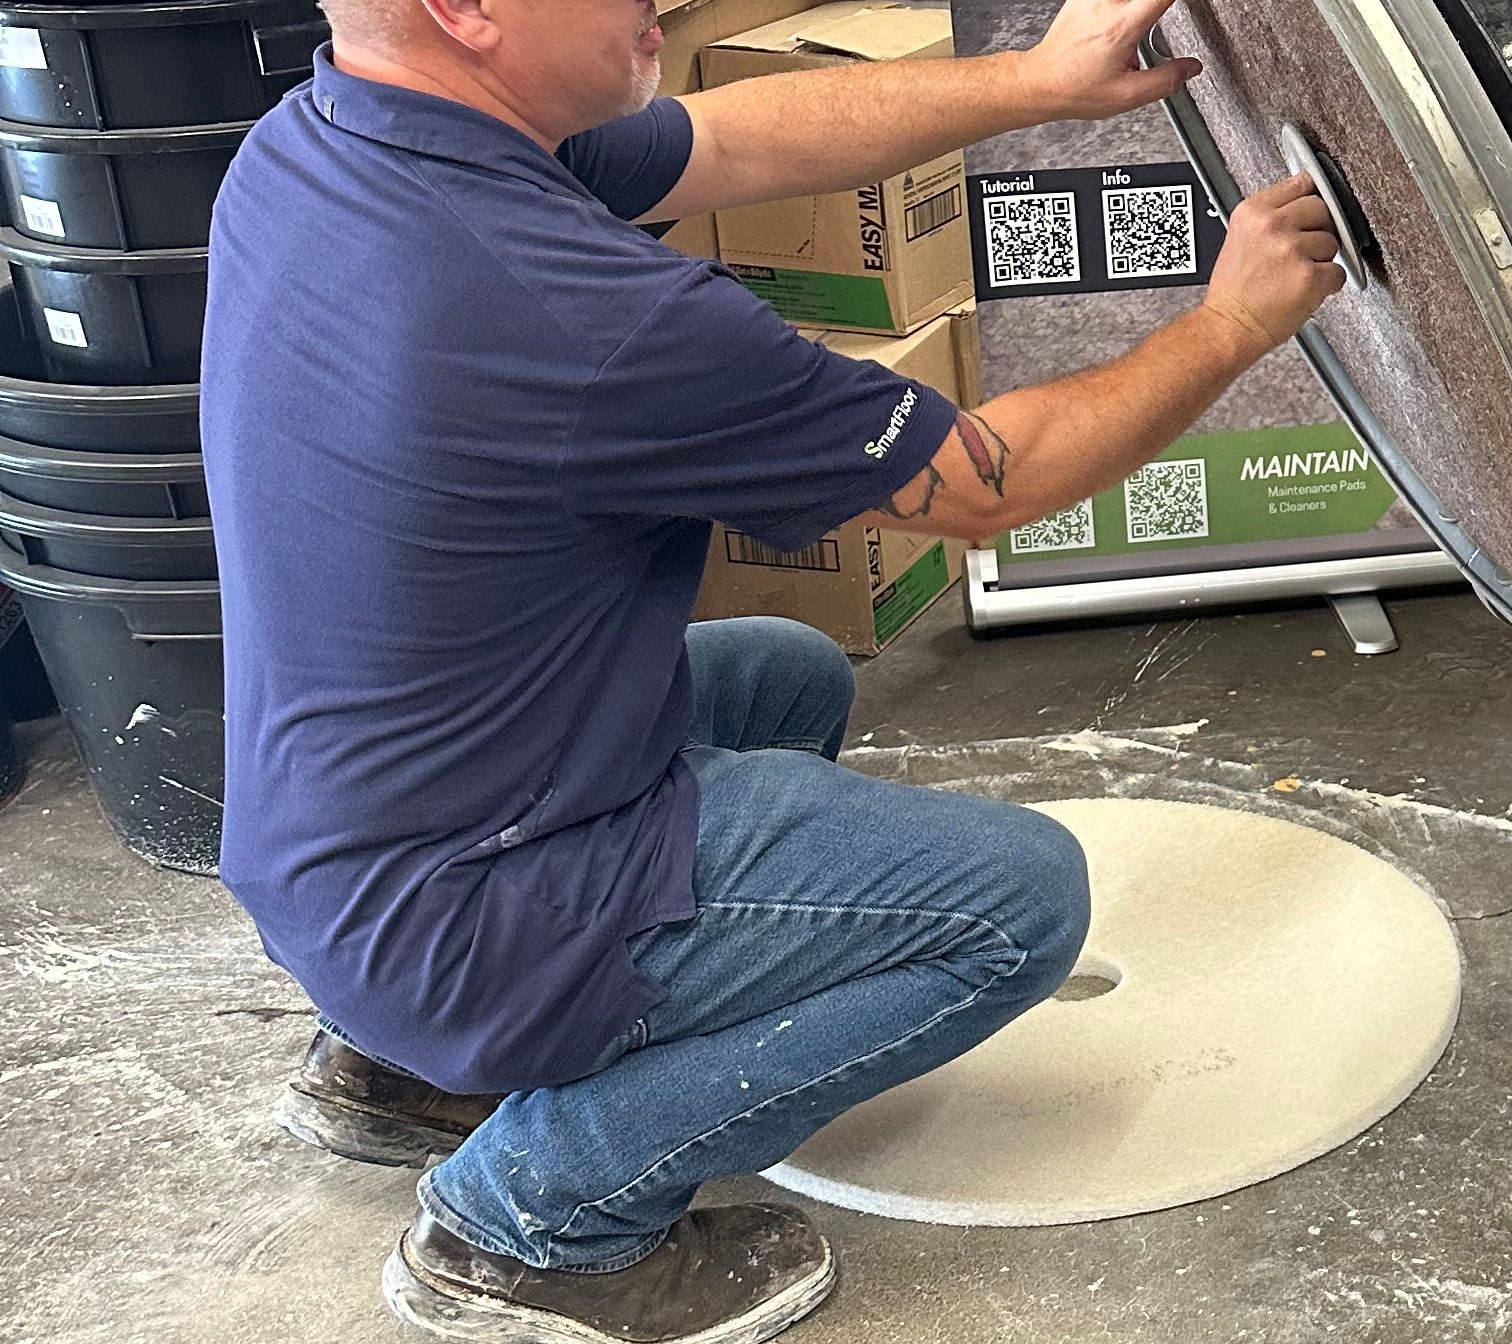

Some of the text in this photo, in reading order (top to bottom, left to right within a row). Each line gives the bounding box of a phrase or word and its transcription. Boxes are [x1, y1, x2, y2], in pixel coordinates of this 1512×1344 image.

[980, 174, 1035, 195] Tutorial
[1101, 168, 1131, 186] Info
[861, 214, 887, 272] EASY
[864, 388, 918, 459] SmartFloor
[1240, 448, 1370, 481] MAINTAIN
[1267, 478, 1366, 498] Maintenance Pads
[1268, 500, 1327, 514] & Cleaners
[865, 540, 887, 592] EASY
